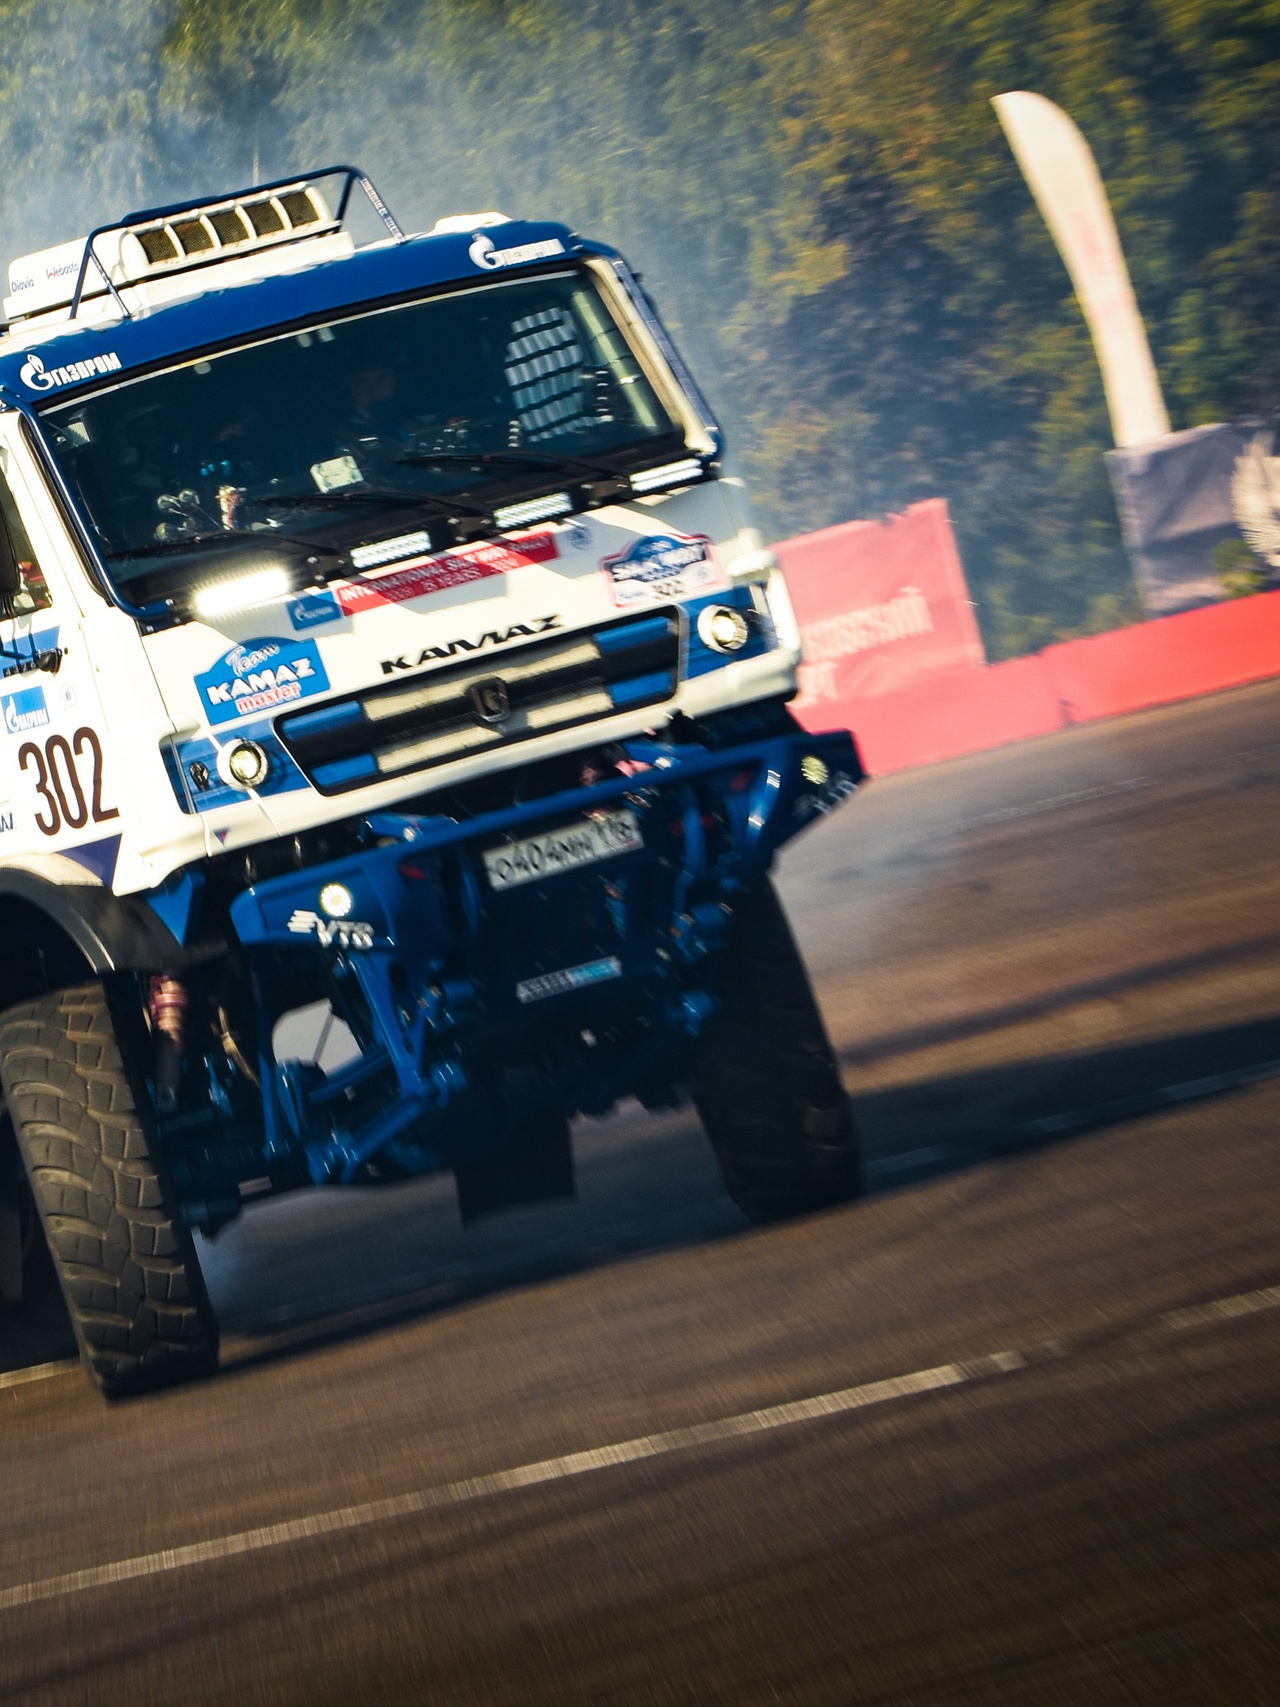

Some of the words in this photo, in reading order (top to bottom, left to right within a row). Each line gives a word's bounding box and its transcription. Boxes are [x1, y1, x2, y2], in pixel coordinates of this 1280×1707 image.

[45, 262, 80, 280] Webasto
[51, 352, 123, 387] ГАЗПРОМ
[225, 642, 281, 677] Team
[378, 614, 564, 675] KAMAZ
[206, 657, 316, 706] KAMAZ
[234, 681, 302, 715] master
[18, 726, 120, 836] 302
